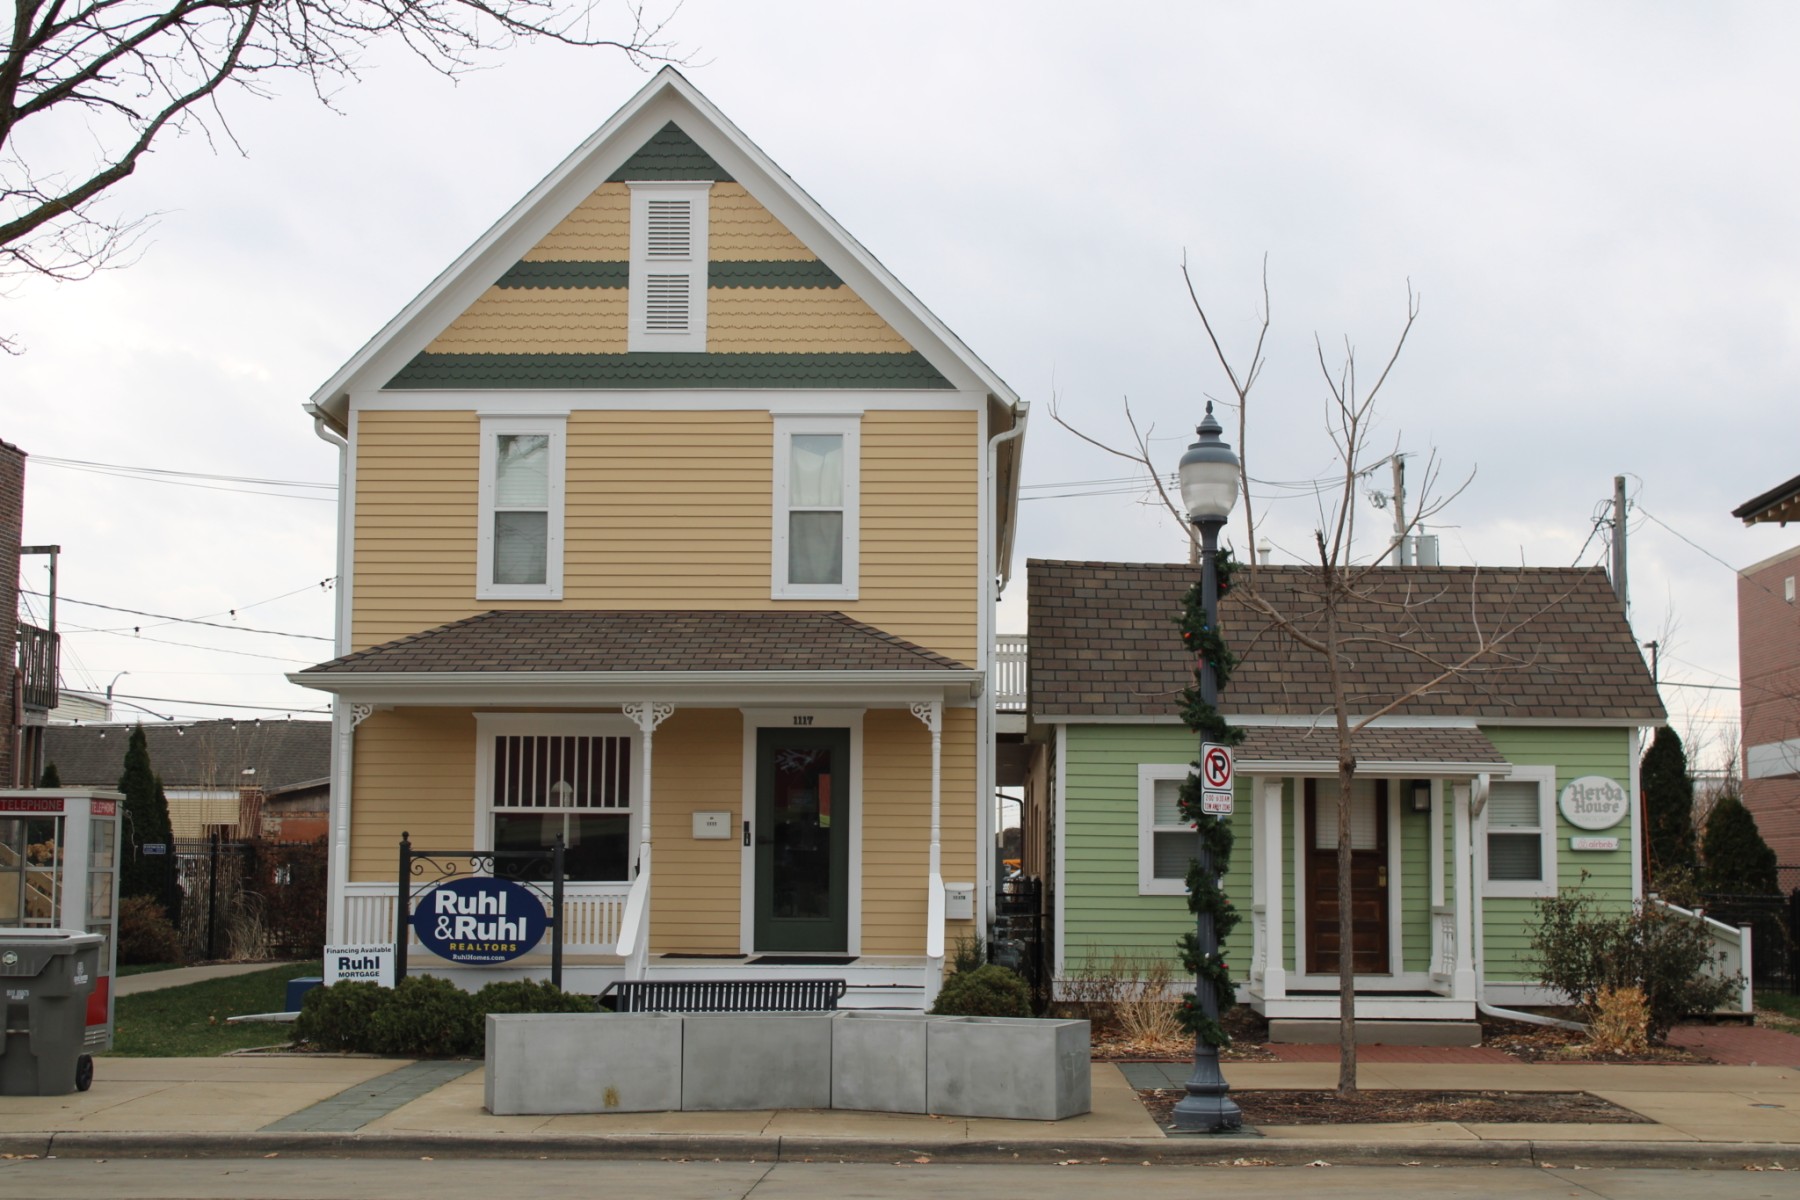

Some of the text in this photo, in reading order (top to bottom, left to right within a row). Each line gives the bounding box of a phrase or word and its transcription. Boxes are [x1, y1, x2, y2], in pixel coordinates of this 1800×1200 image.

[793, 716, 814, 725] 1117
[1568, 782, 1623, 801] Herda
[1, 799, 63, 810] TELEPHONE
[92, 800, 115, 814] TELEPHONE
[1573, 799, 1619, 813] House
[1588, 840, 1613, 848] airbnb
[435, 890, 507, 915] Ruhl
[449, 943, 517, 952] REALTORS
[338, 956, 380, 970] Ruhl
[452, 953, 506, 961] RuhlHomes.com
